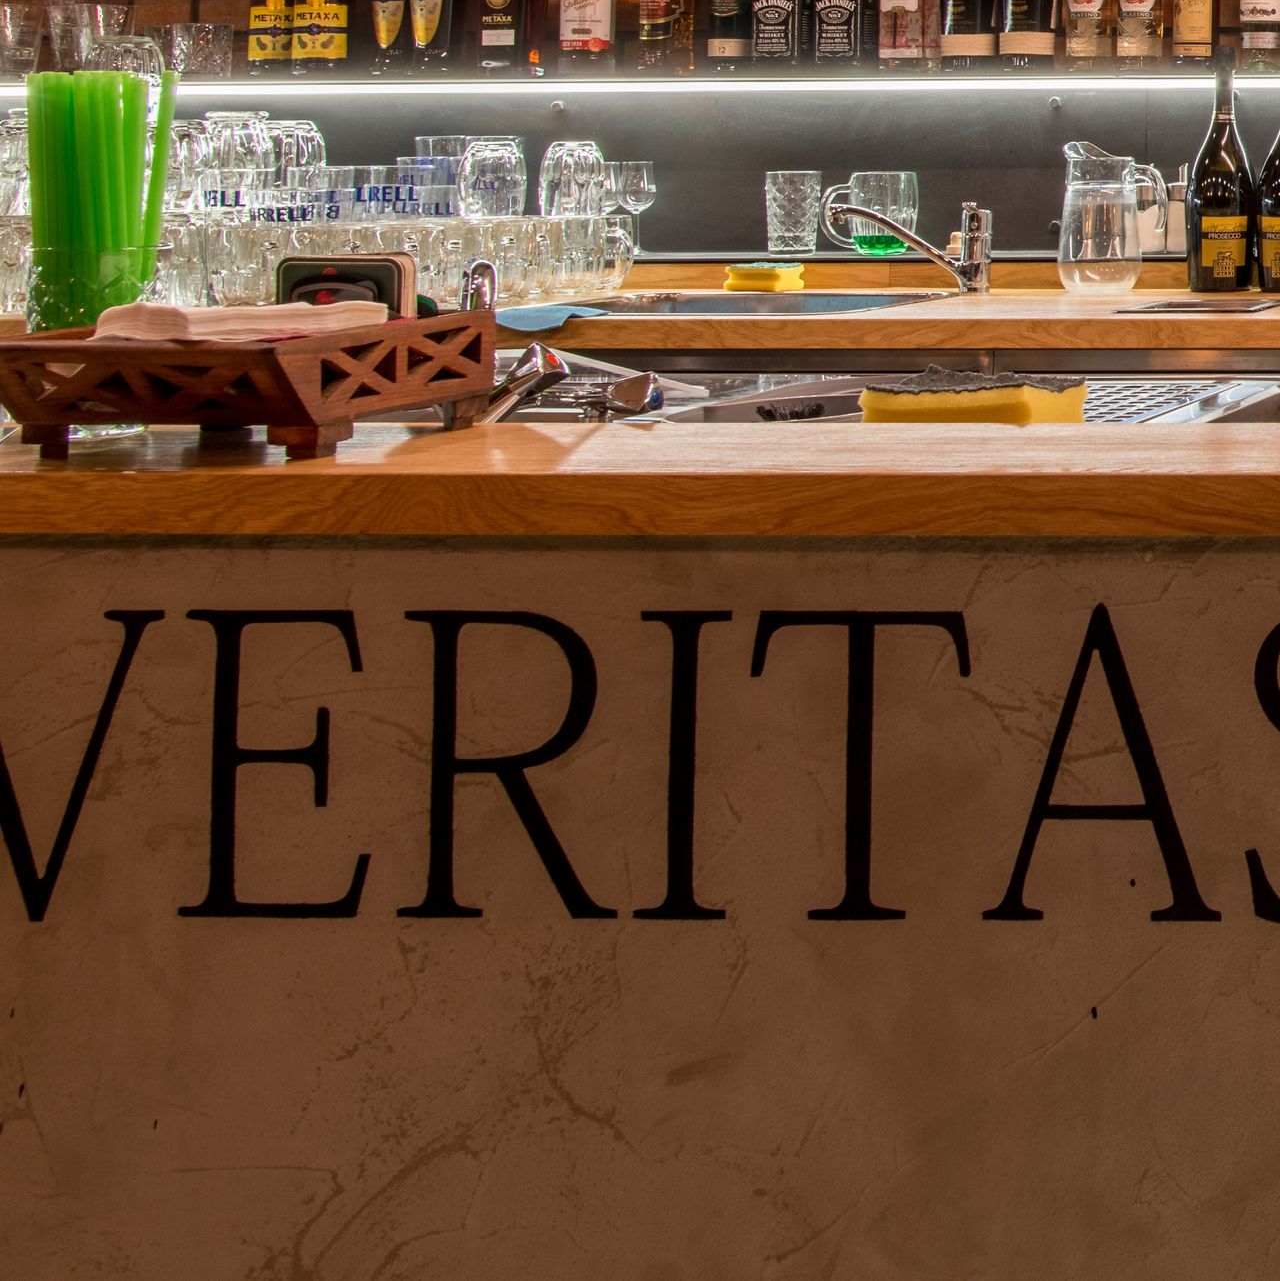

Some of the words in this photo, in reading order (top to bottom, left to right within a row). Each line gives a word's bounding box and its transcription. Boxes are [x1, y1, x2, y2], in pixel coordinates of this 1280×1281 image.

[753, 0, 767, 12] JACK
[816, 0, 830, 12] JACK
[296, 11, 340, 21] METAXA
[482, 15, 512, 23] METAXA
[1208, 232, 1241, 240] PROSECCO
